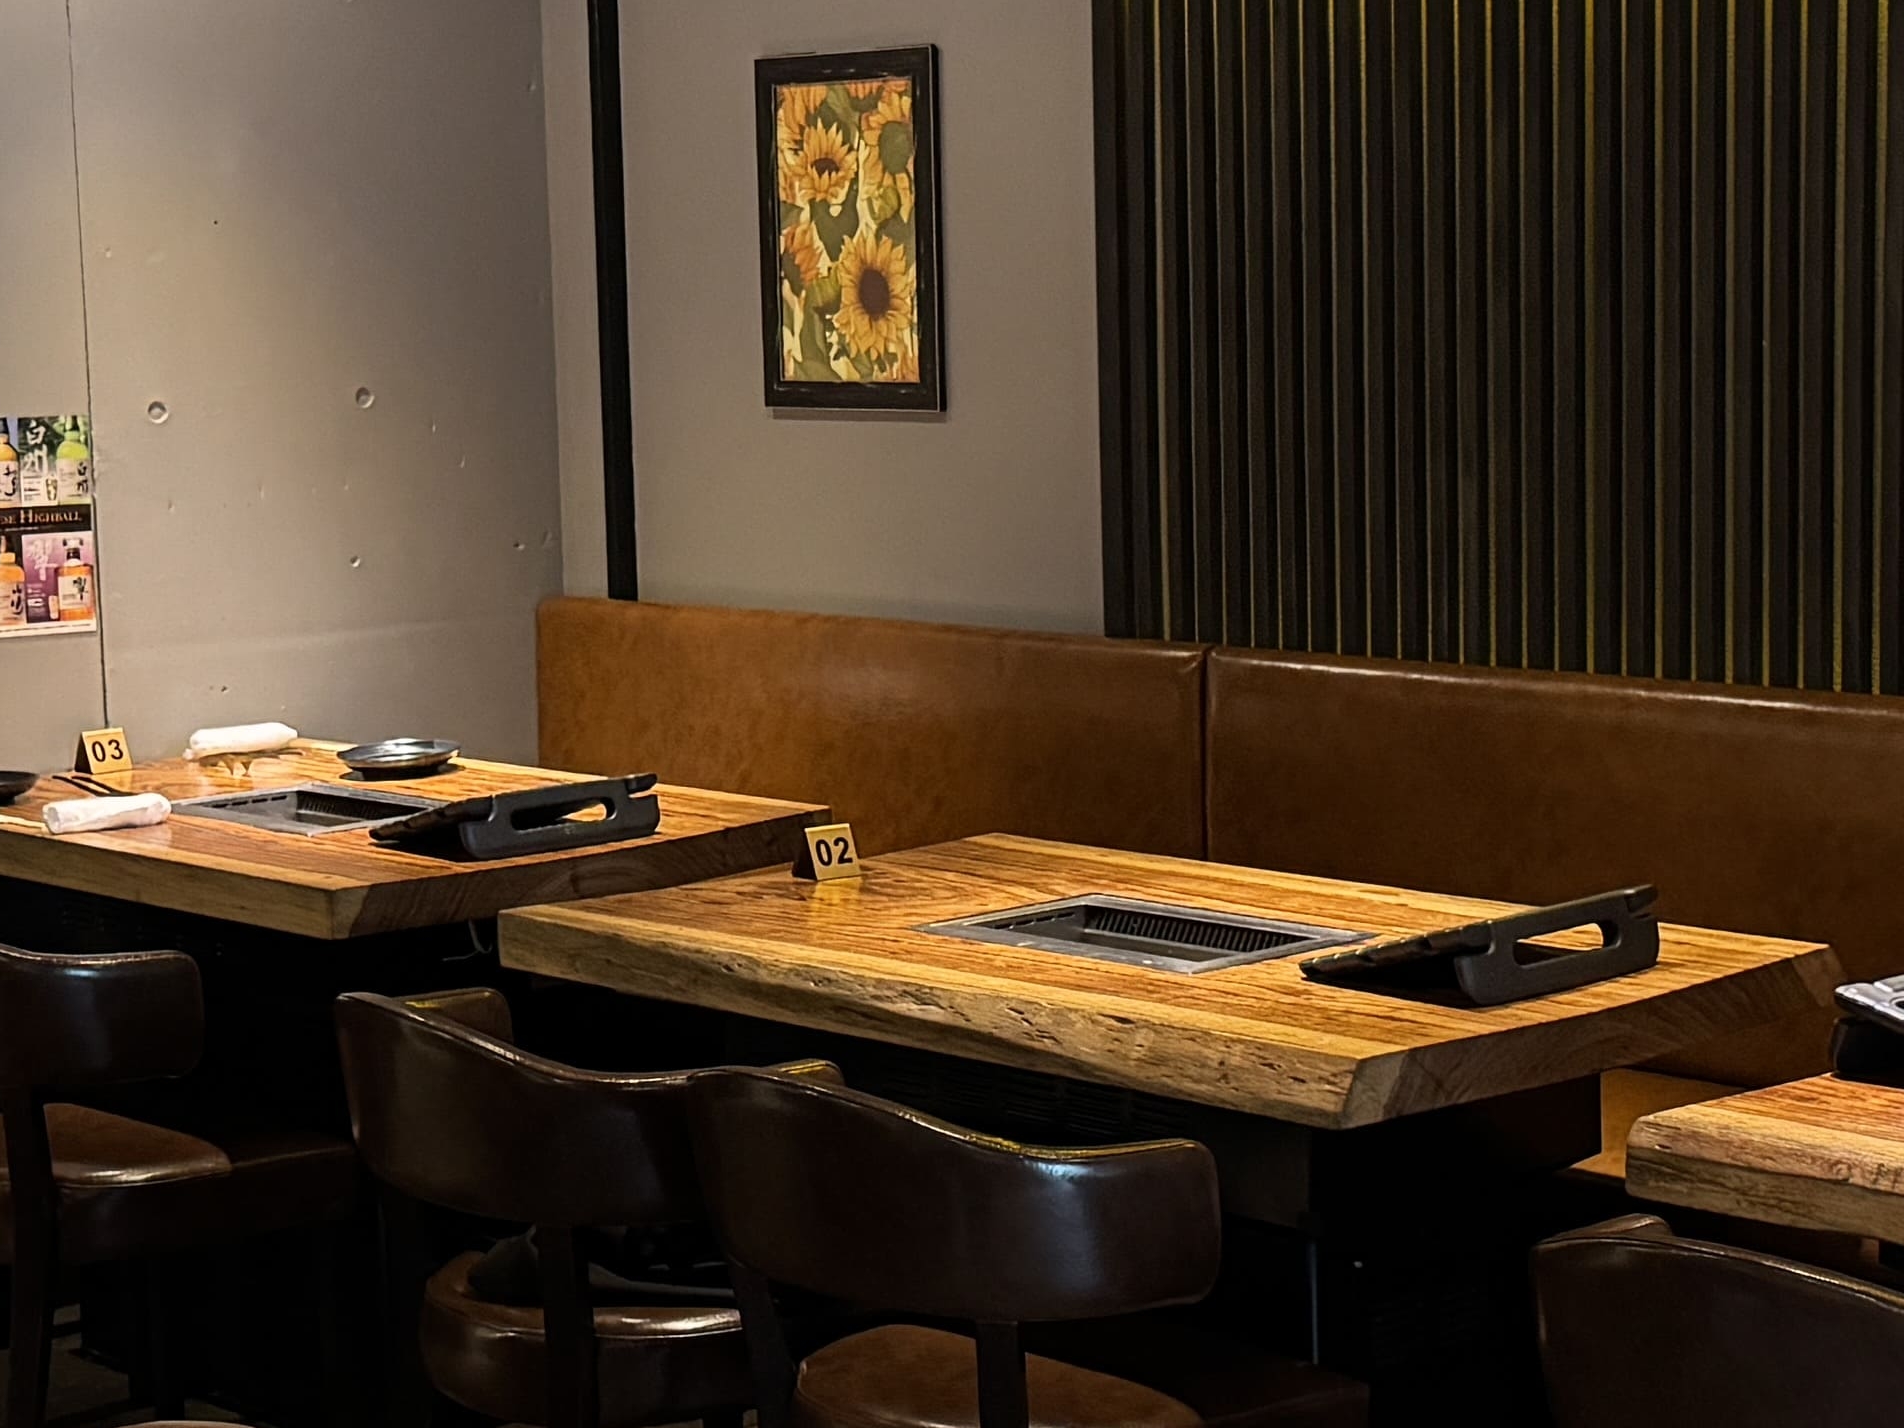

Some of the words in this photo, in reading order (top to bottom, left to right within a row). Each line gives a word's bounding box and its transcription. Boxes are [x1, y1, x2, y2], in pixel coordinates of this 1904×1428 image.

[20, 509, 83, 524] HIGHBALL
[91, 739, 124, 762] 03
[815, 836, 853, 867] 02
